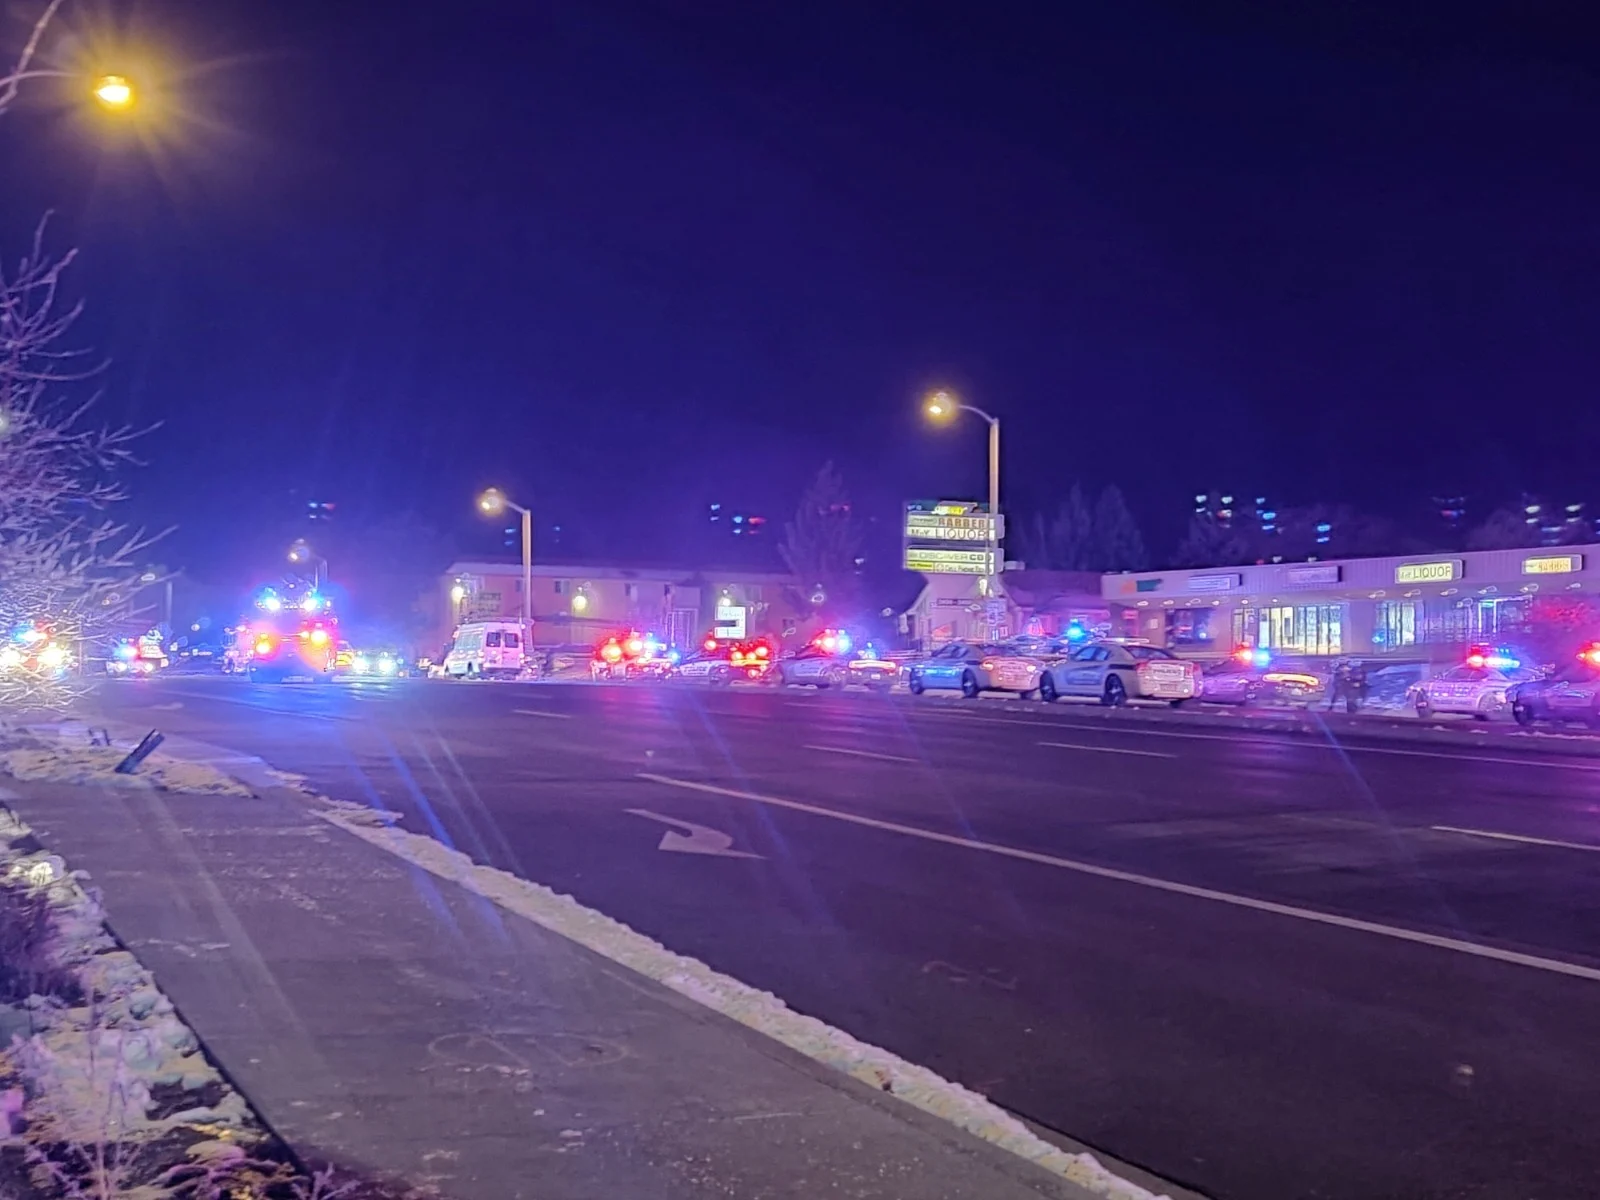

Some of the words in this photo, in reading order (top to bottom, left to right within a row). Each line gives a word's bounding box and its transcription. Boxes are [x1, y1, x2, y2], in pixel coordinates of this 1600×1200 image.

[938, 518, 985, 528] BARBER
[936, 528, 987, 539] LIQUOR
[1412, 565, 1451, 579] LIQUOR
